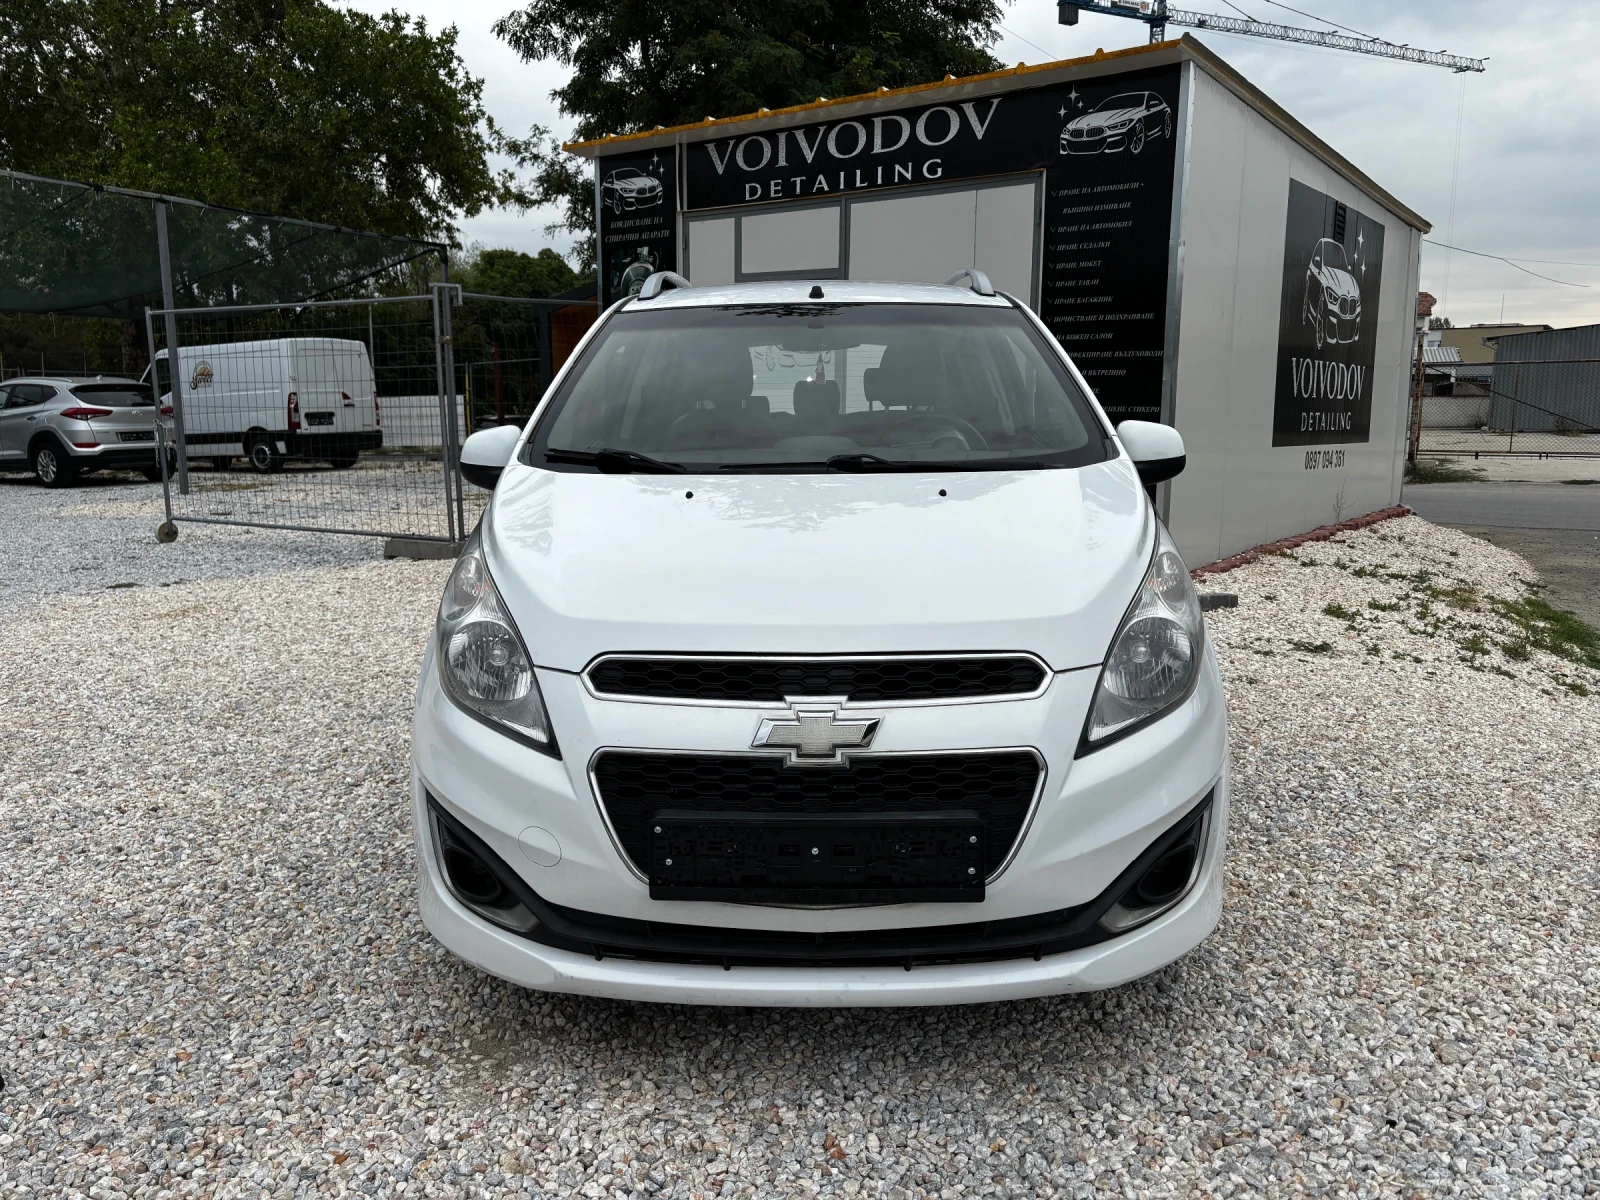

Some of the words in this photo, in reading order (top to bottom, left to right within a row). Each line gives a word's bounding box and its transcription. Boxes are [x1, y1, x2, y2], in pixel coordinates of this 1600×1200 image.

[704, 97, 1003, 175] VOIVODOV
[745, 158, 943, 201] DETAILING
[1292, 357, 1366, 401] VOIVODOV
[1300, 412, 1352, 432] DETAILING
[1304, 450, 1321, 470] 0897
[1321, 450, 1333, 469] 094
